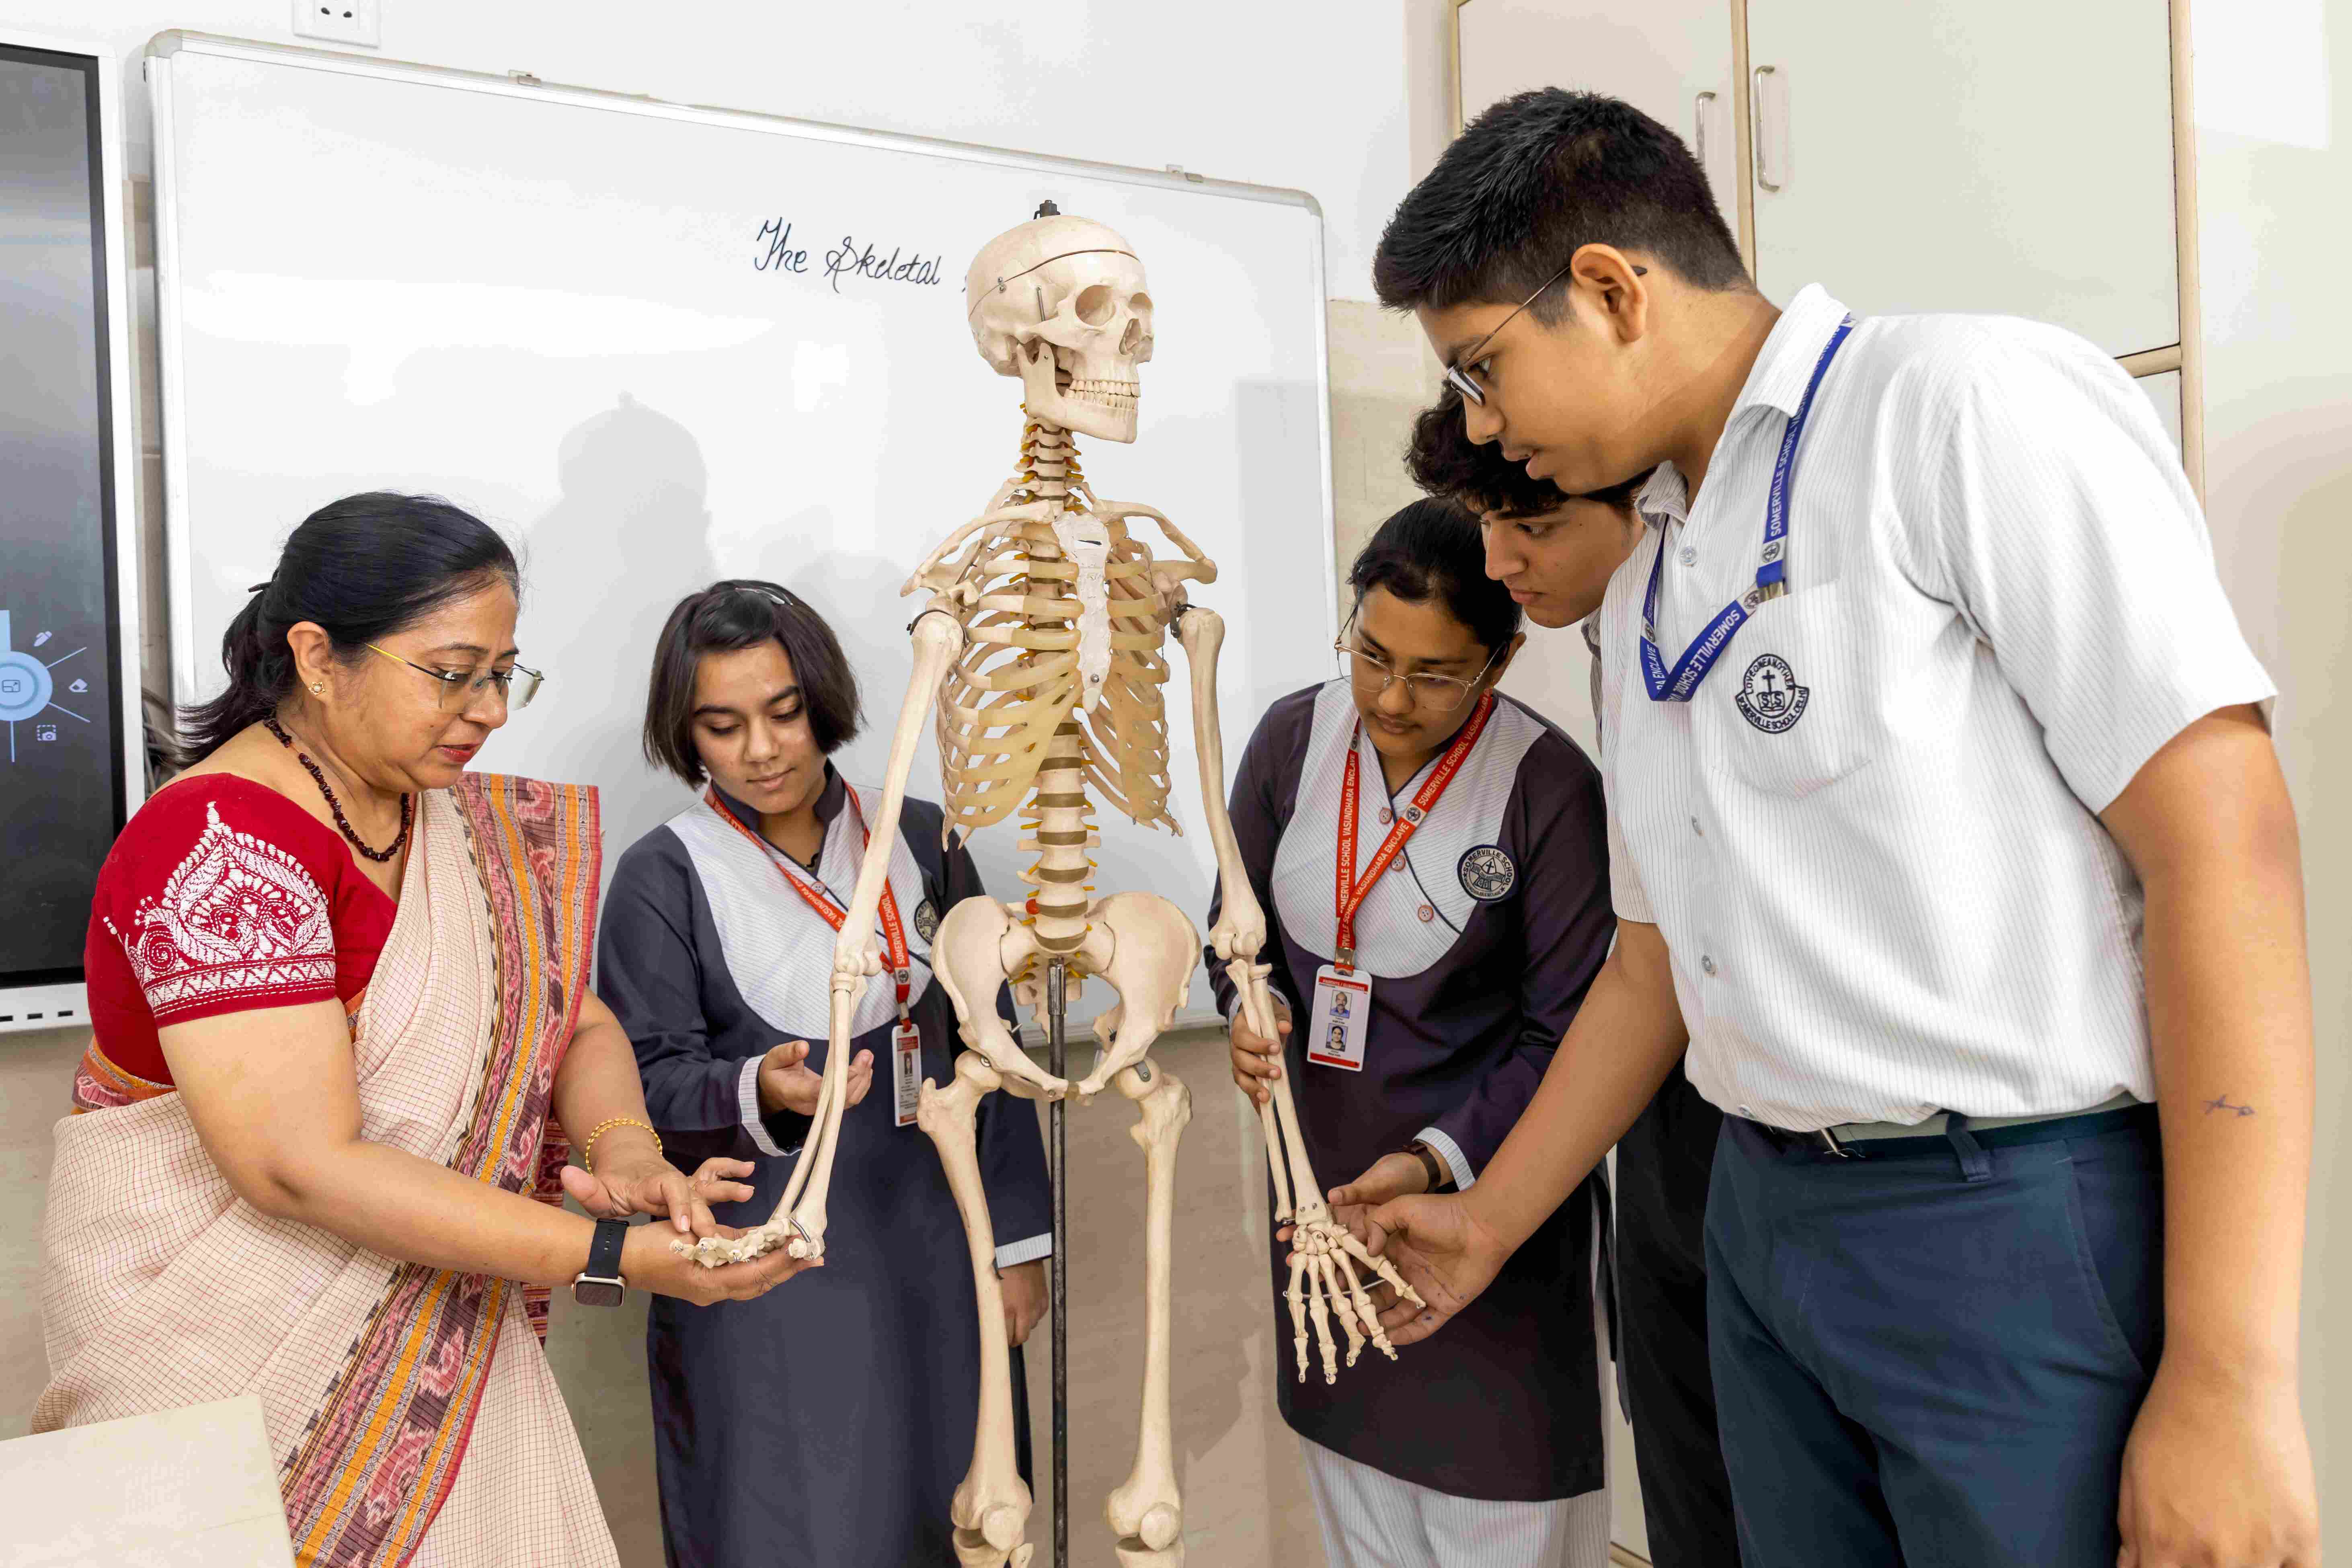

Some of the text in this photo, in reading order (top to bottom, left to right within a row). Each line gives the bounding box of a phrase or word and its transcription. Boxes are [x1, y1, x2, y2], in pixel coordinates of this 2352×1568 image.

[755, 217, 941, 293] The Skeletal
[1771, 426, 1797, 537] SOMERVILLE SCHOOL
[1647, 644, 1666, 679] ENCLAVE
[1689, 610, 1740, 671] SOMERVILLE
[1348, 754, 1356, 787] ENCLAVE
[1418, 764, 1451, 806] SOMERVILLE
[1447, 739, 1468, 767] SCHOOL
[1342, 788, 1354, 837] VASUNDHARA
[1341, 837, 1351, 866] SCHOOL
[1356, 853, 1387, 895] VASUNDHARA
[1384, 822, 1409, 853] ENCLAVE
[1463, 849, 1502, 872] SOMERVILLE
[1502, 857, 1513, 886] SCHOOL
[882, 895, 896, 920] SCHOOL
[889, 921, 905, 965] SOMERVILLE
